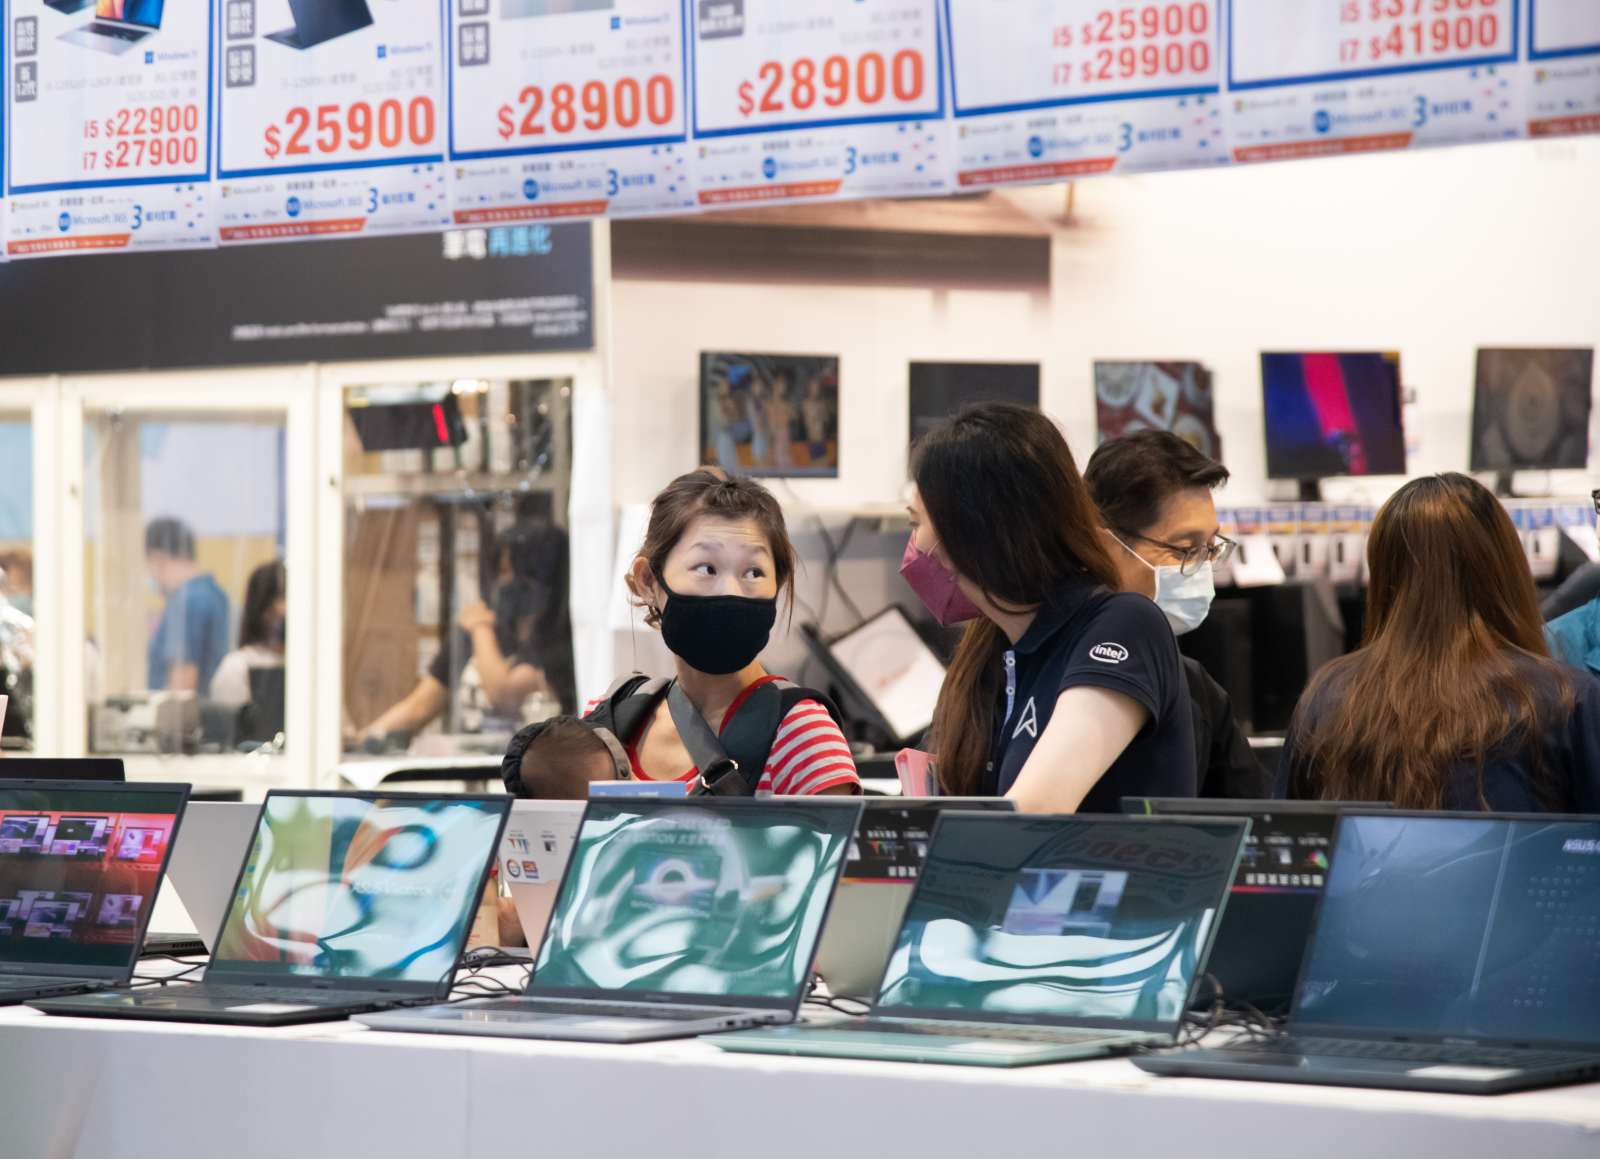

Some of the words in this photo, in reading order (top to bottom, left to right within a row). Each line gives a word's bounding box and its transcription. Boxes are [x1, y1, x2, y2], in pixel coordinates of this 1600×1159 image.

[1081, 2, 1210, 46] $25900
[1369, 13, 1499, 61] $41900
[1081, 40, 1211, 83] $29900
[736, 48, 926, 117] $28900
[84, 120, 99, 140] i5
[105, 103, 199, 138] $22900
[497, 73, 676, 142] $28900
[262, 95, 437, 160] $25900
[1117, 122, 1133, 151] 3
[82, 150, 98, 171] i7
[104, 135, 198, 170] $27900
[843, 146, 857, 175] 3
[366, 187, 379, 213] 3
[606, 168, 619, 196] 3
[130, 204, 143, 230] 3
[1095, 644, 1123, 660] intel
